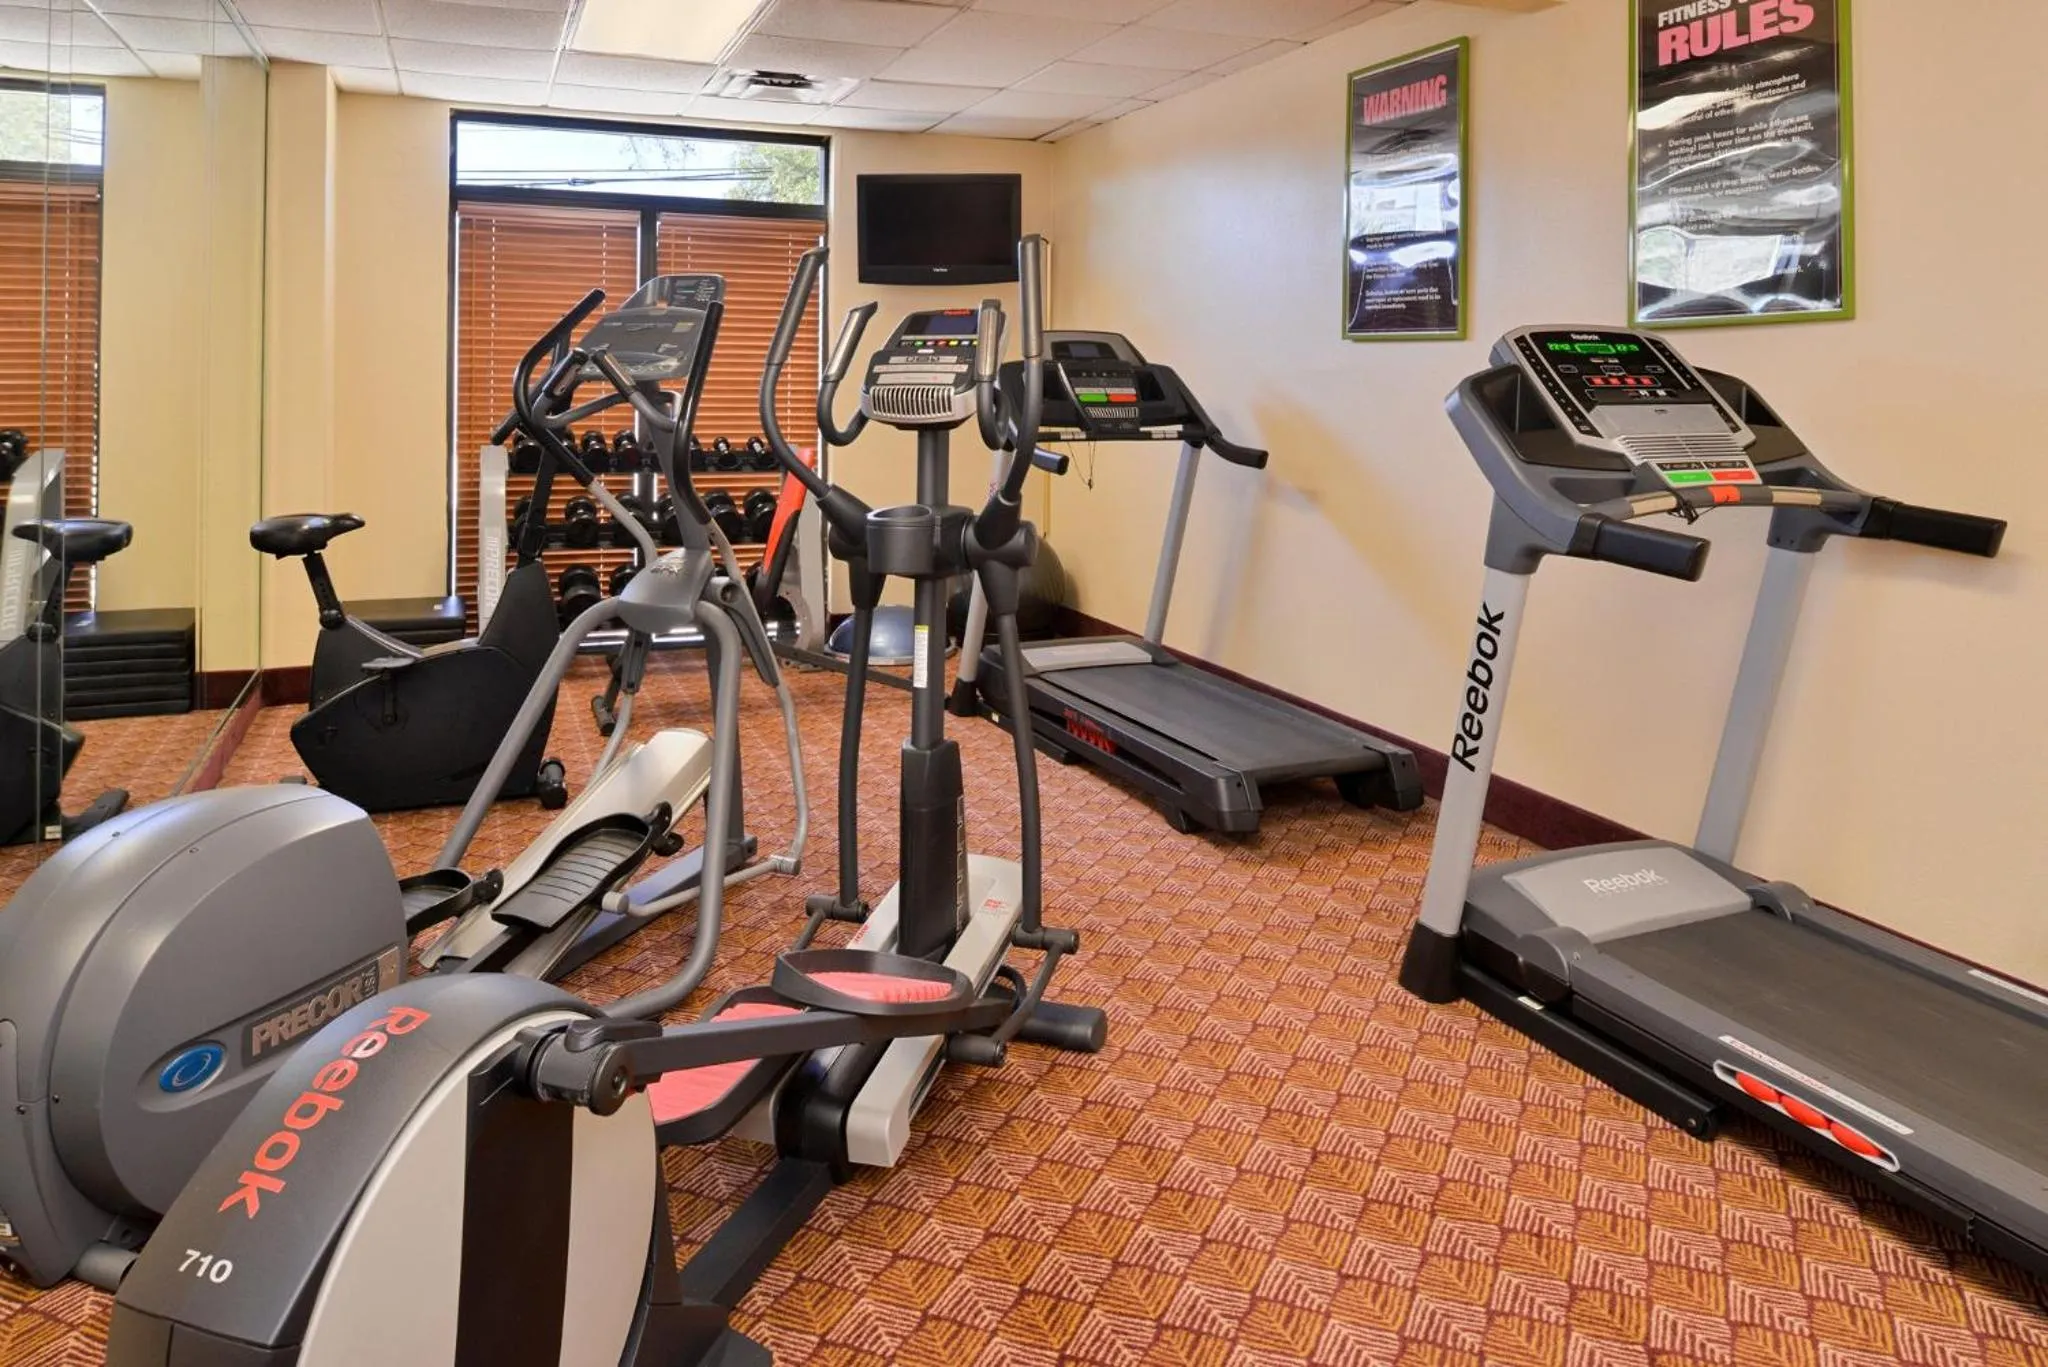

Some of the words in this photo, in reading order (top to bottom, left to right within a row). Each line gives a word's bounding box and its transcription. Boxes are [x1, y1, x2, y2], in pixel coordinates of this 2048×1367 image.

[1658, 0, 1732, 28] FITNESS
[1658, 0, 1814, 66] RULES
[1363, 74, 1448, 126] WARNING
[1790, 80, 1806, 91] and
[1668, 137, 1693, 148] During
[1694, 132, 1711, 143] peak
[1716, 139, 1733, 149] your
[1734, 135, 1751, 145] time
[1668, 186, 1692, 195] Please
[1694, 182, 1709, 192] pick
[1451, 602, 1505, 772] Reebok
[1583, 868, 1665, 894] Reebok
[252, 975, 363, 1057] PRECOR
[216, 1005, 432, 1219] Reebok
[178, 1248, 233, 1284] 710
